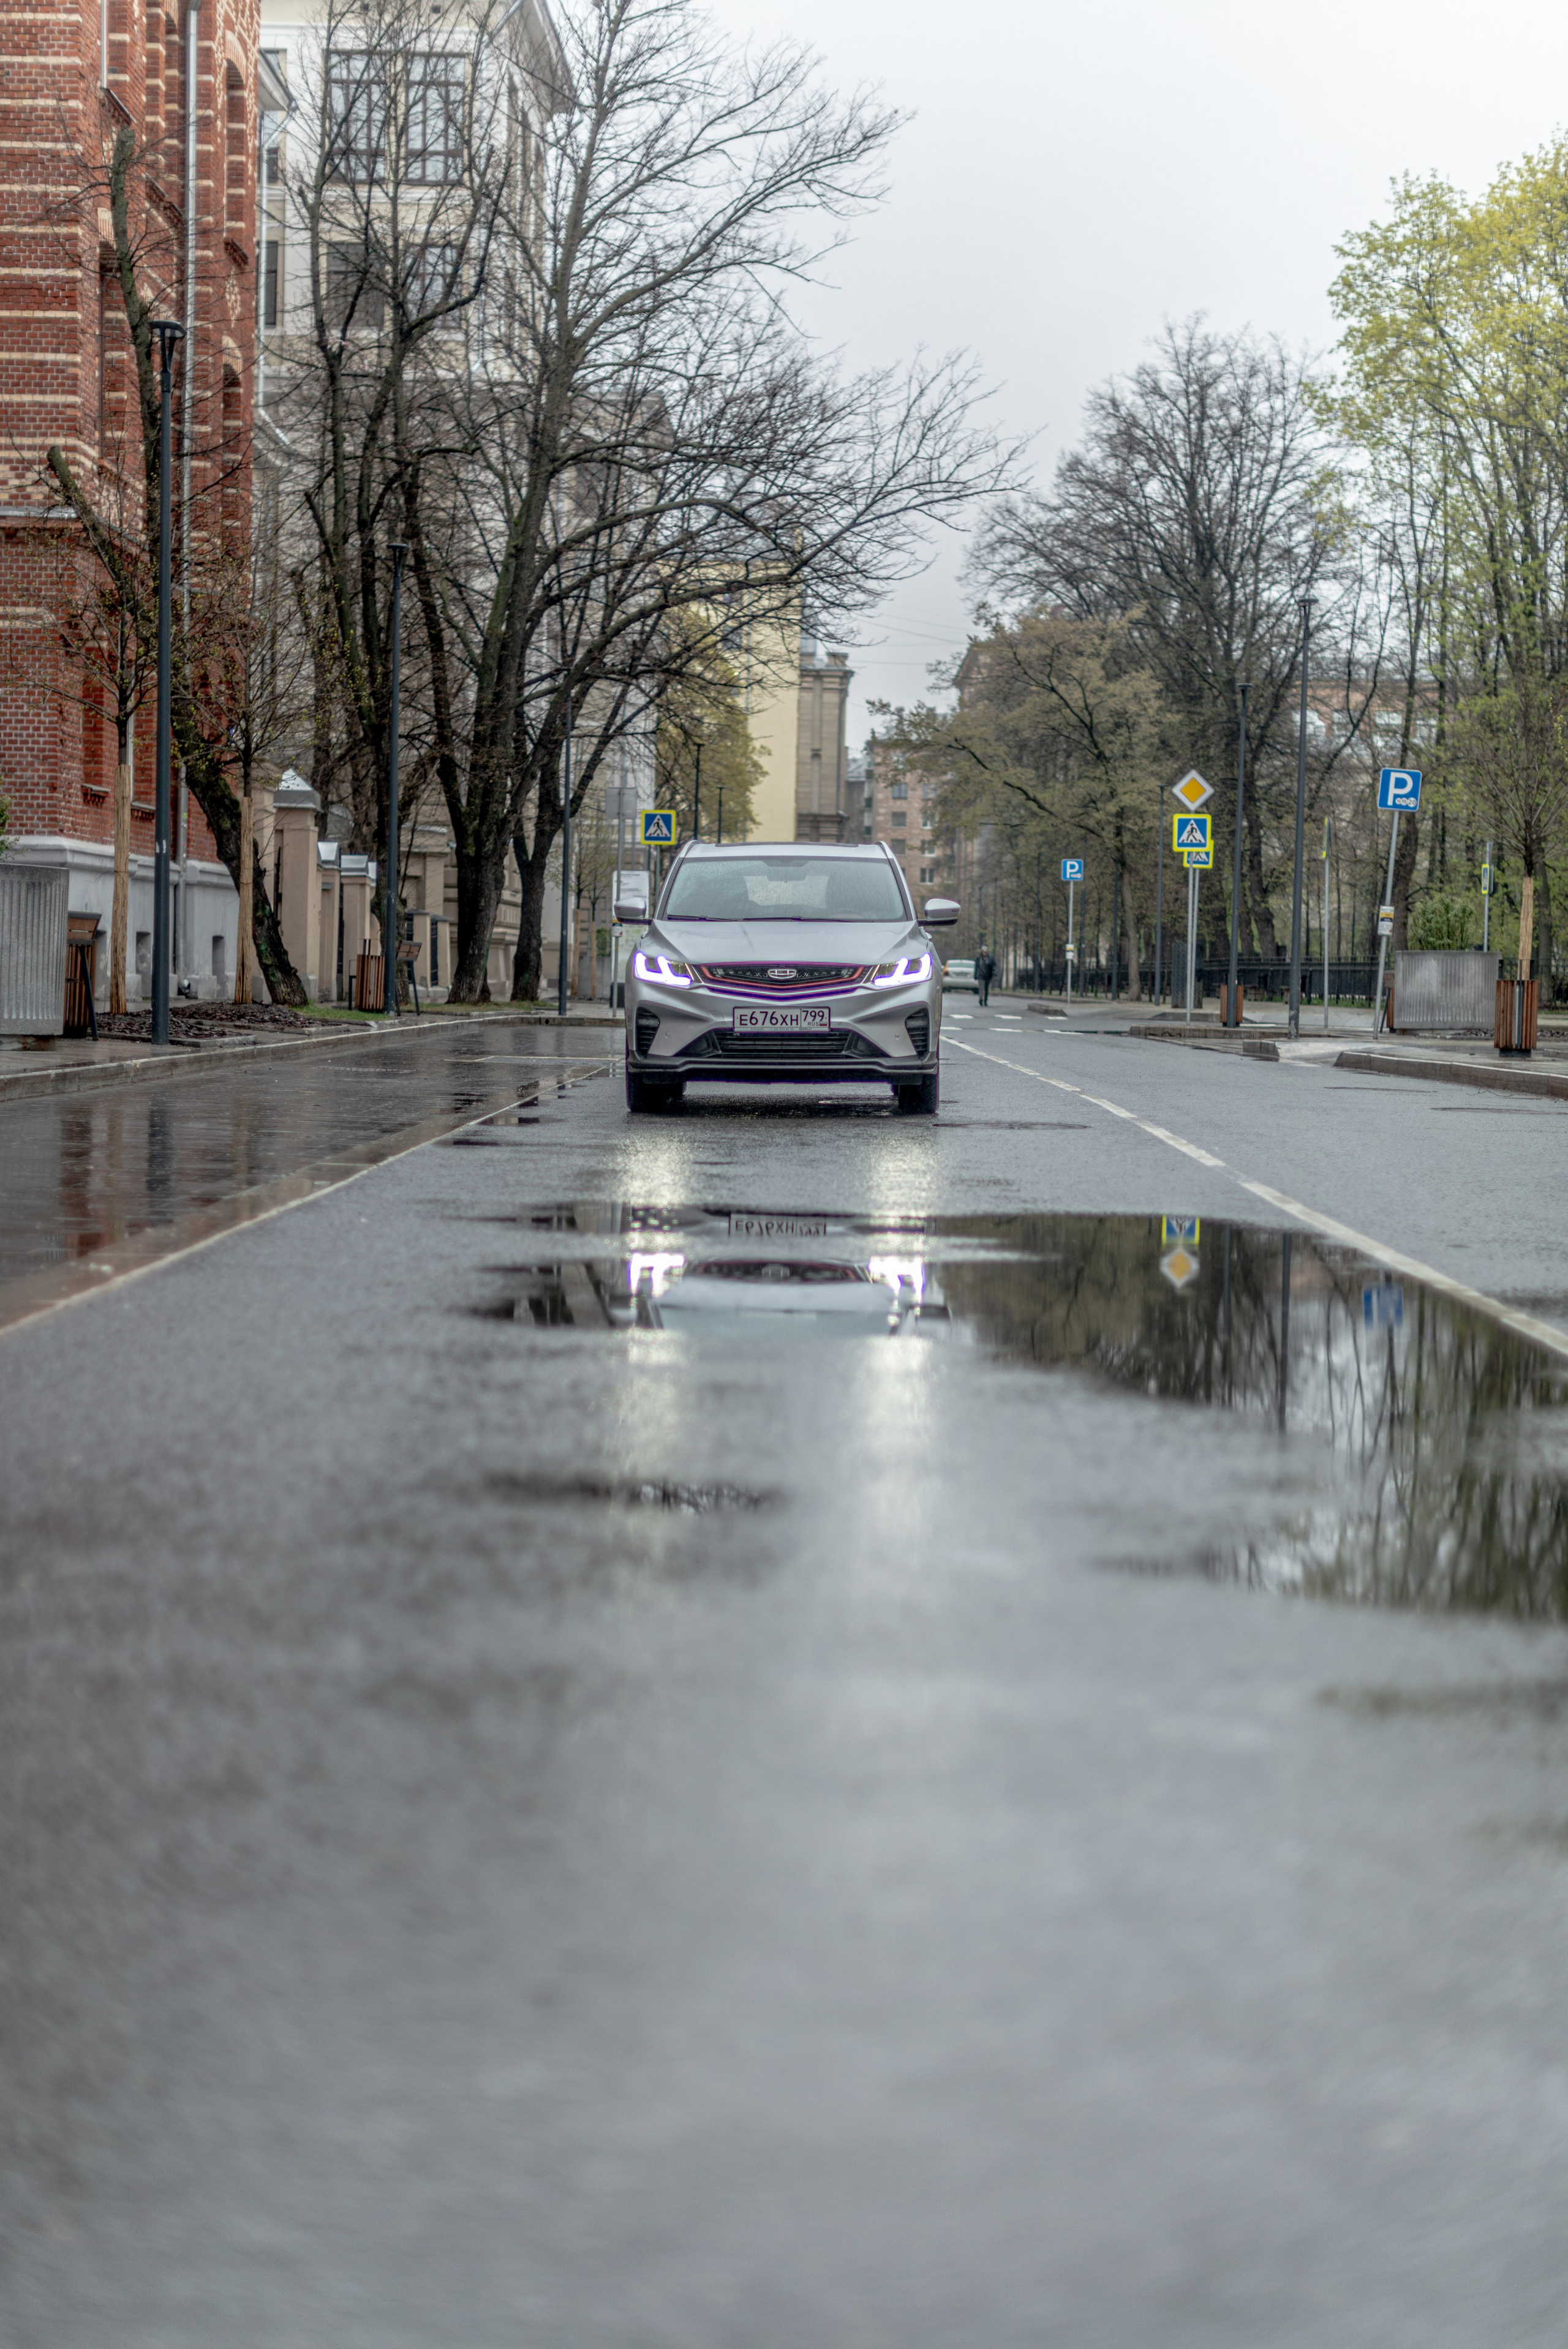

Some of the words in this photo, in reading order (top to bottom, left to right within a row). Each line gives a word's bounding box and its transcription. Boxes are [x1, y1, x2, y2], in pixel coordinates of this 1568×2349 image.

[1387, 772, 1413, 805] P
[1066, 861, 1079, 878] P
[802, 1010, 824, 1021] 799
